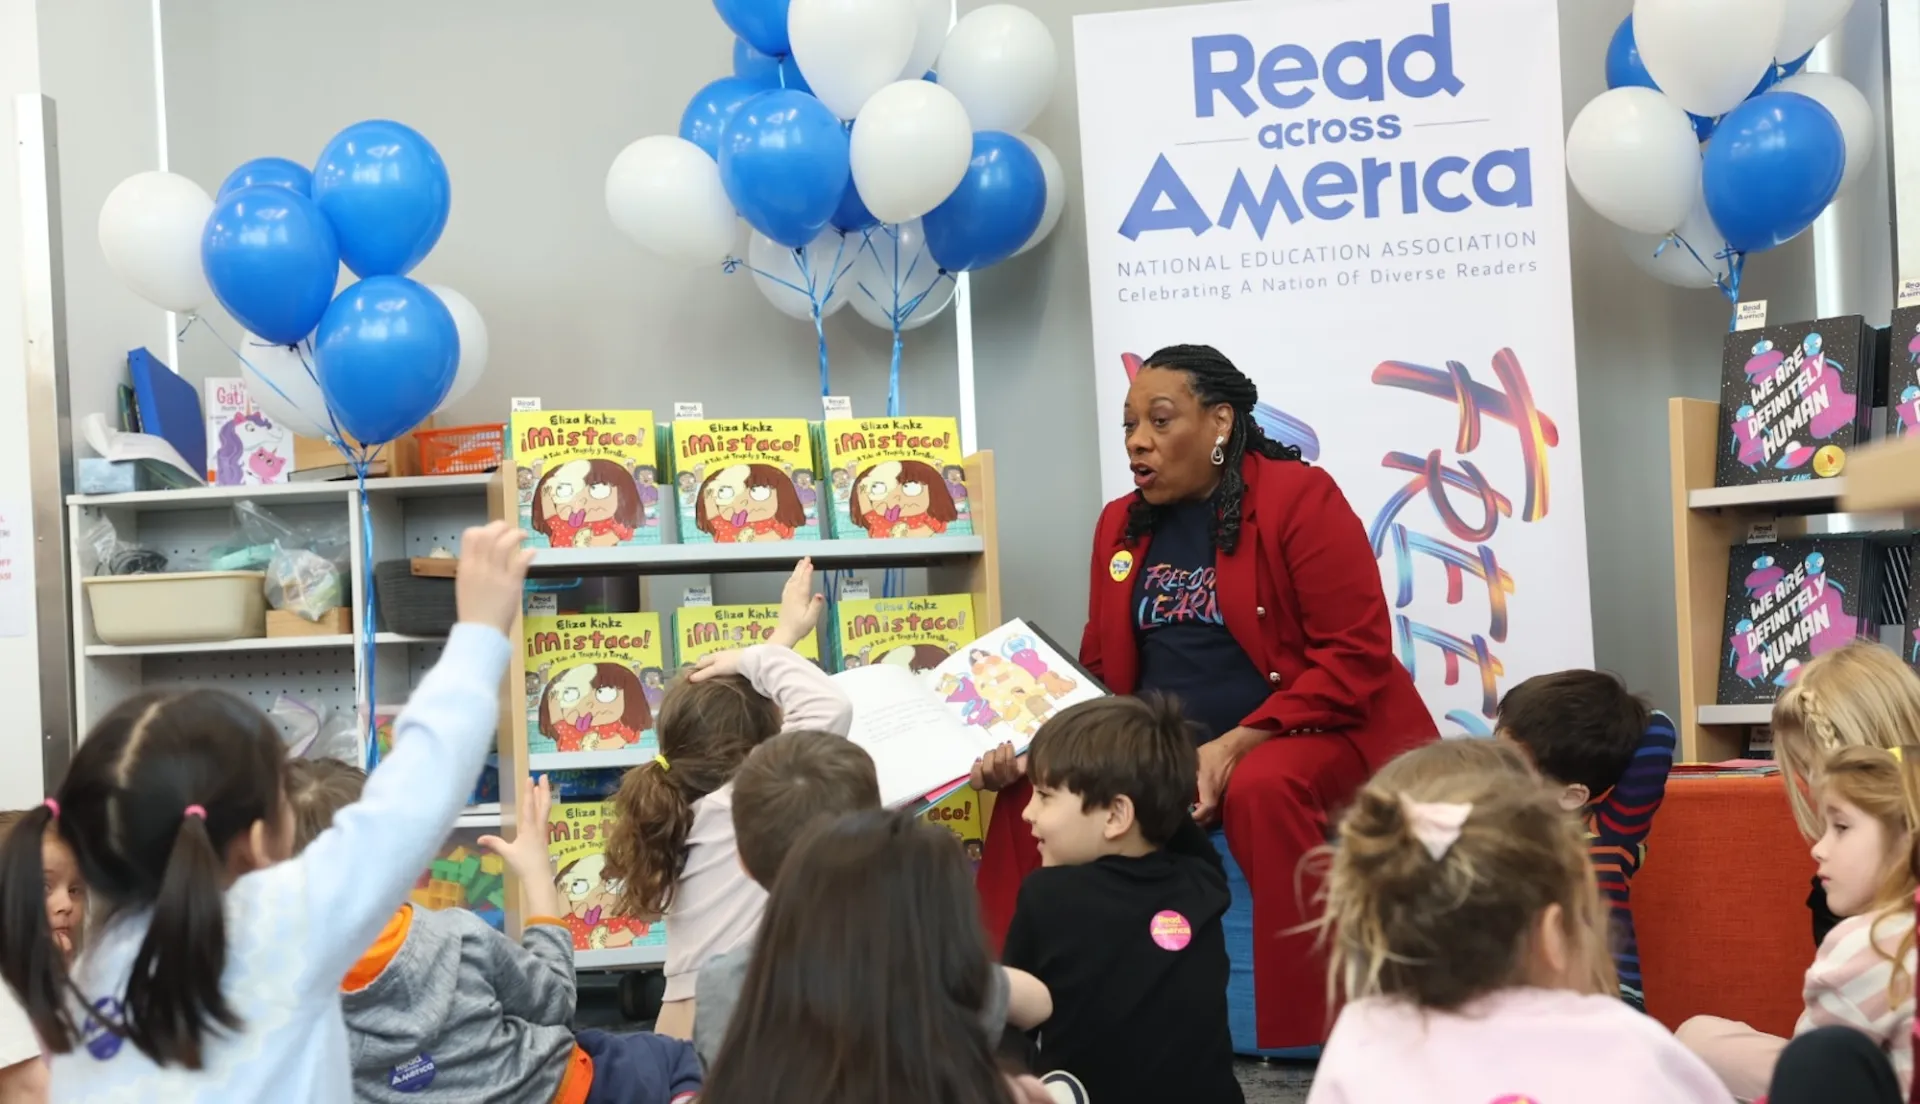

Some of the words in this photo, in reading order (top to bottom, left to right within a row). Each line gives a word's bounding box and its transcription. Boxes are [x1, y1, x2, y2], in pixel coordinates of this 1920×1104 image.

[1192, 3, 1465, 118] Read
[1258, 114, 1401, 150] across
[1117, 147, 1533, 242] America
[1118, 254, 1231, 277] NATIONAL
[1241, 243, 1370, 268] EDUCATION
[1382, 230, 1536, 258] ASSOCIATION
[1118, 283, 1232, 303] Celebrating
[1241, 279, 1252, 294] A
[1263, 276, 1327, 292] Nation
[1337, 269, 1360, 287] Of
[1371, 267, 1446, 284] Diverse
[1456, 259, 1538, 278] Readers
[1751, 376, 1774, 406] WE
[1774, 343, 1804, 388] ARE
[1747, 350, 1825, 441] DEFINITELY
[550, 415, 580, 425] Eliza
[584, 413, 616, 425] Kinkz
[709, 423, 738, 433] Eliza
[742, 421, 773, 432] Kinkz
[861, 421, 889, 431] Eliza
[893, 419, 923, 430] Kinkz
[1762, 384, 1830, 463] HUMAN
[521, 427, 645, 452] ¡Mistaco!
[681, 433, 801, 458] ¡Mistaco!
[834, 431, 950, 455] ¡Mistaco!
[1751, 592, 1774, 620] WE
[1775, 562, 1805, 601] ARE
[715, 610, 744, 621] Eliza
[875, 603, 904, 613] Eliza
[907, 599, 938, 610] Kinkz
[1138, 586, 1224, 629] LEARN
[1746, 571, 1826, 654] DEFINITELY
[556, 620, 586, 630] Eliza
[590, 617, 622, 628] Kinkz
[687, 621, 775, 648] ¡Mista
[847, 611, 966, 640] ¡Mistaco!
[527, 630, 651, 657] ¡Mistaco!
[1760, 603, 1830, 678] HUMAN
[566, 808, 596, 819] Eliza
